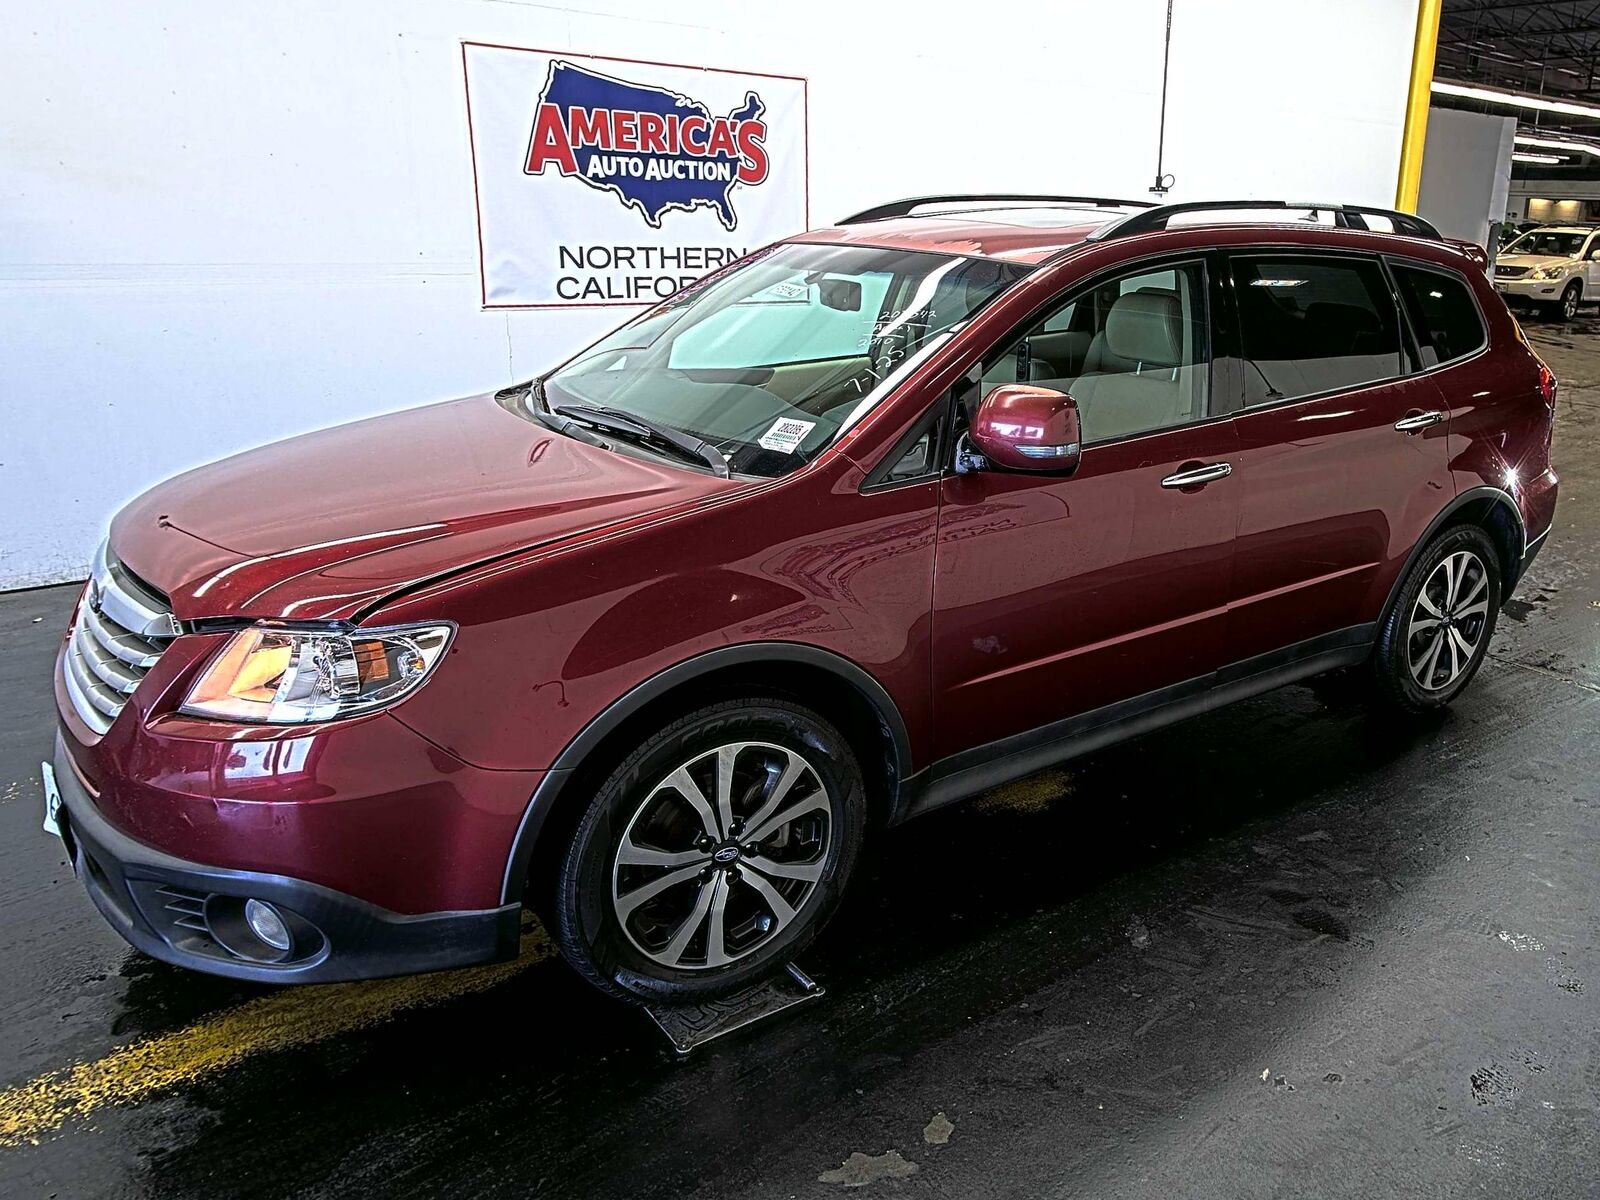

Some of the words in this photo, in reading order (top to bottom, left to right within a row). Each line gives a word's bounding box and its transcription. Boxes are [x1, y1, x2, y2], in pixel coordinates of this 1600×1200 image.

[527, 103, 768, 184] AMERICA'S
[587, 154, 640, 179] AUTO
[644, 157, 731, 182] AUCTION
